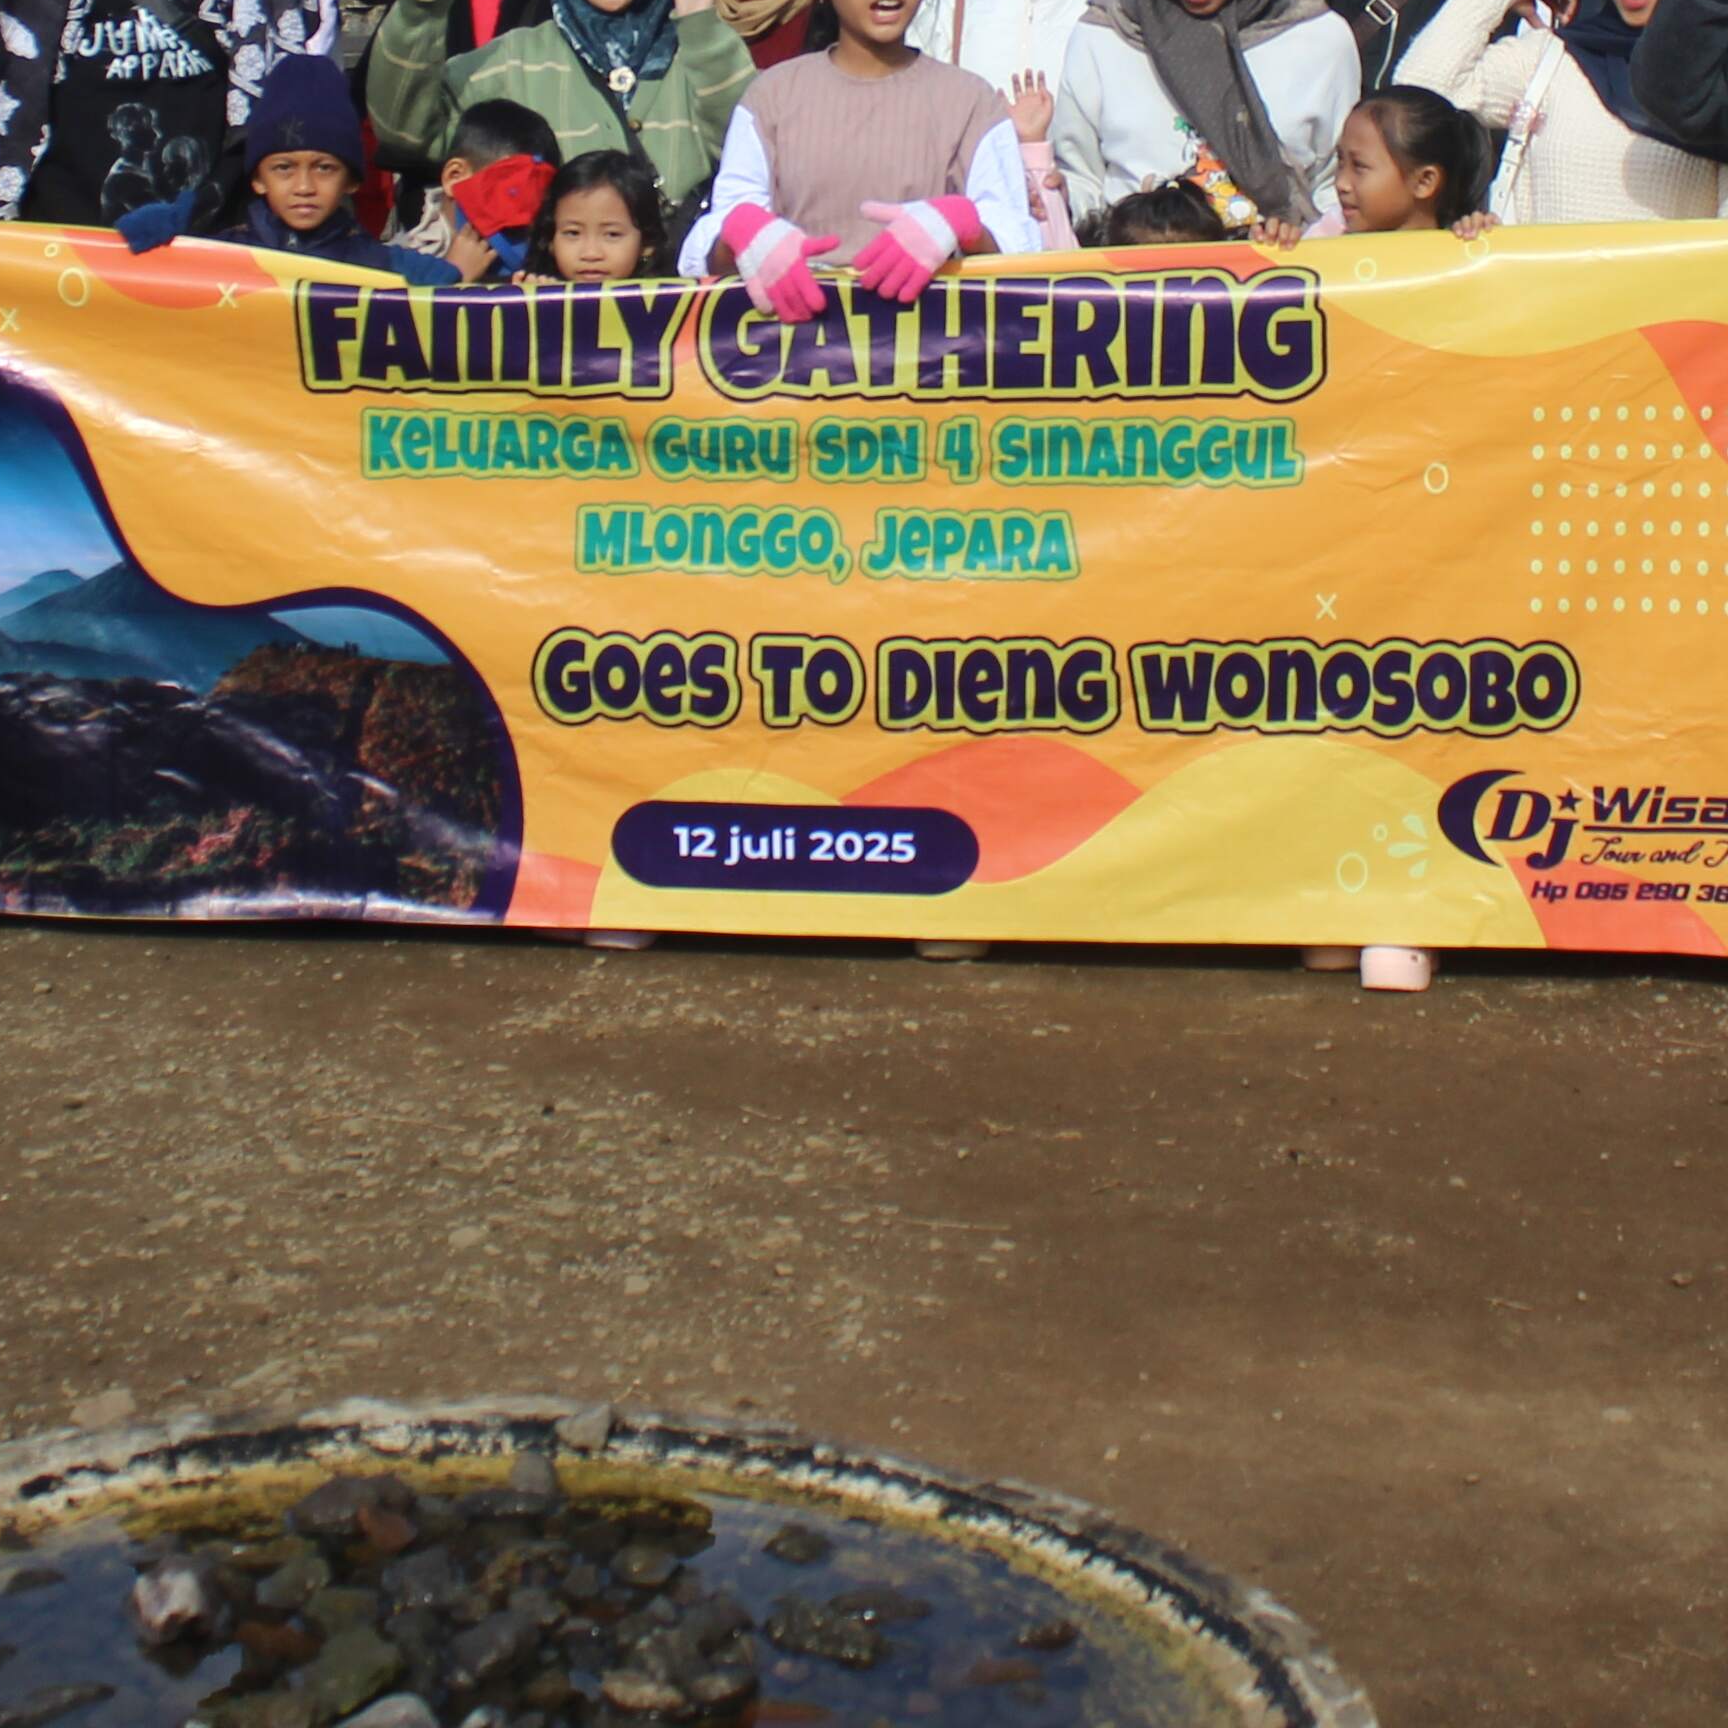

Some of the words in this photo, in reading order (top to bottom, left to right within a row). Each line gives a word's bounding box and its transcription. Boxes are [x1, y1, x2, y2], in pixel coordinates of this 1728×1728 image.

[649, 420, 794, 477] GURU
[812, 420, 923, 479] SDN
[940, 420, 976, 479] 4
[756, 639, 860, 722] TO
[672, 825, 717, 858] 12
[724, 825, 796, 865] juli
[808, 829, 917, 864] 2025
[1580, 836, 1646, 866] Tour
[1649, 839, 1703, 865] and
[1530, 880, 1567, 903] Hp
